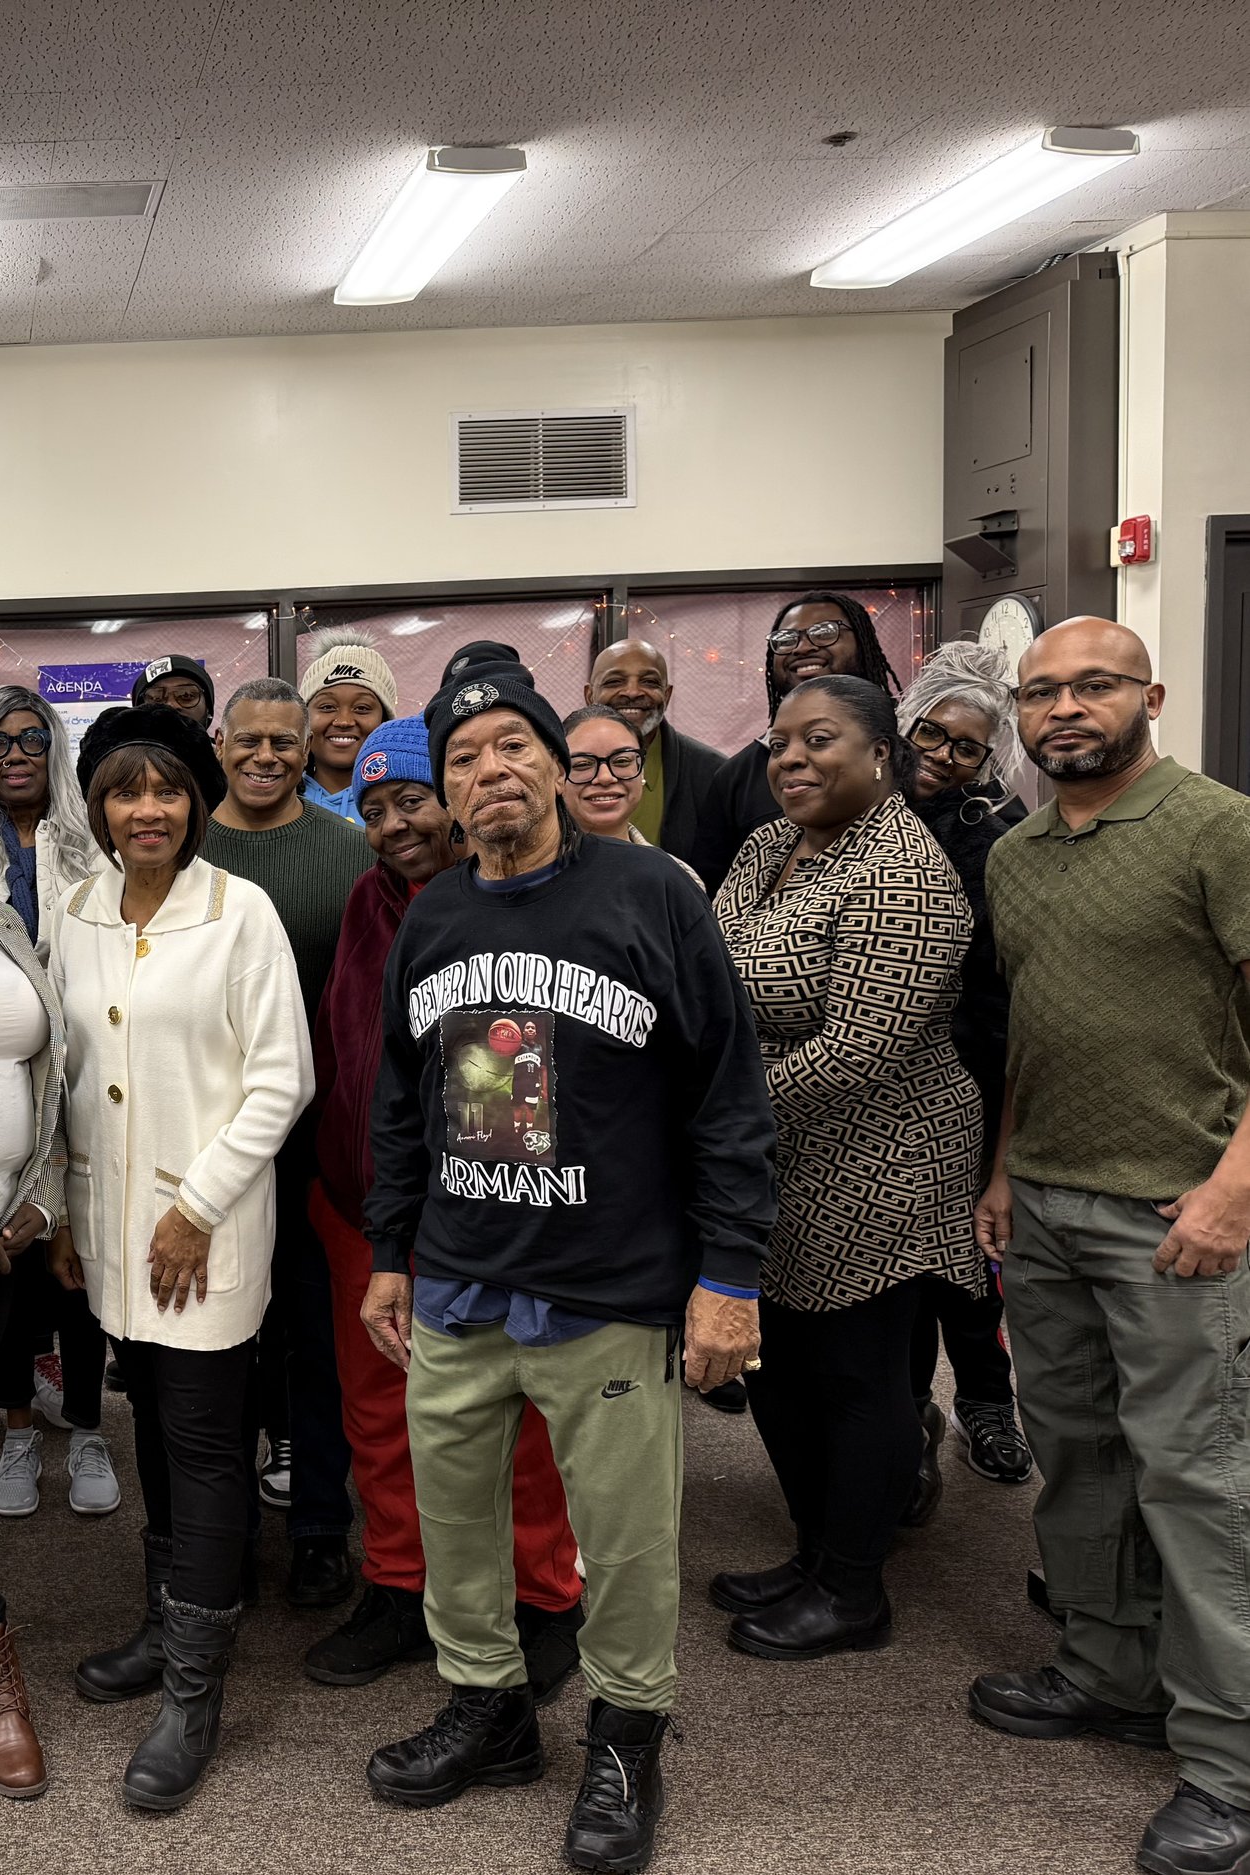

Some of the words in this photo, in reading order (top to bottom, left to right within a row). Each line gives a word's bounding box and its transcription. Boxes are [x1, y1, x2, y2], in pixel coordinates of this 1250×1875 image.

[1001, 602, 1009, 615] 12
[1023, 617, 1029, 629] 2
[330, 664, 366, 679] NIKE
[46, 681, 103, 693] AGENDA
[409, 961, 467, 1041] REVER
[464, 952, 494, 1005] IN
[494, 951, 553, 1009] OUR
[551, 959, 658, 1048] HEARTS
[440, 1152, 587, 1207] ARMANI
[606, 1380, 632, 1392] NIKE
